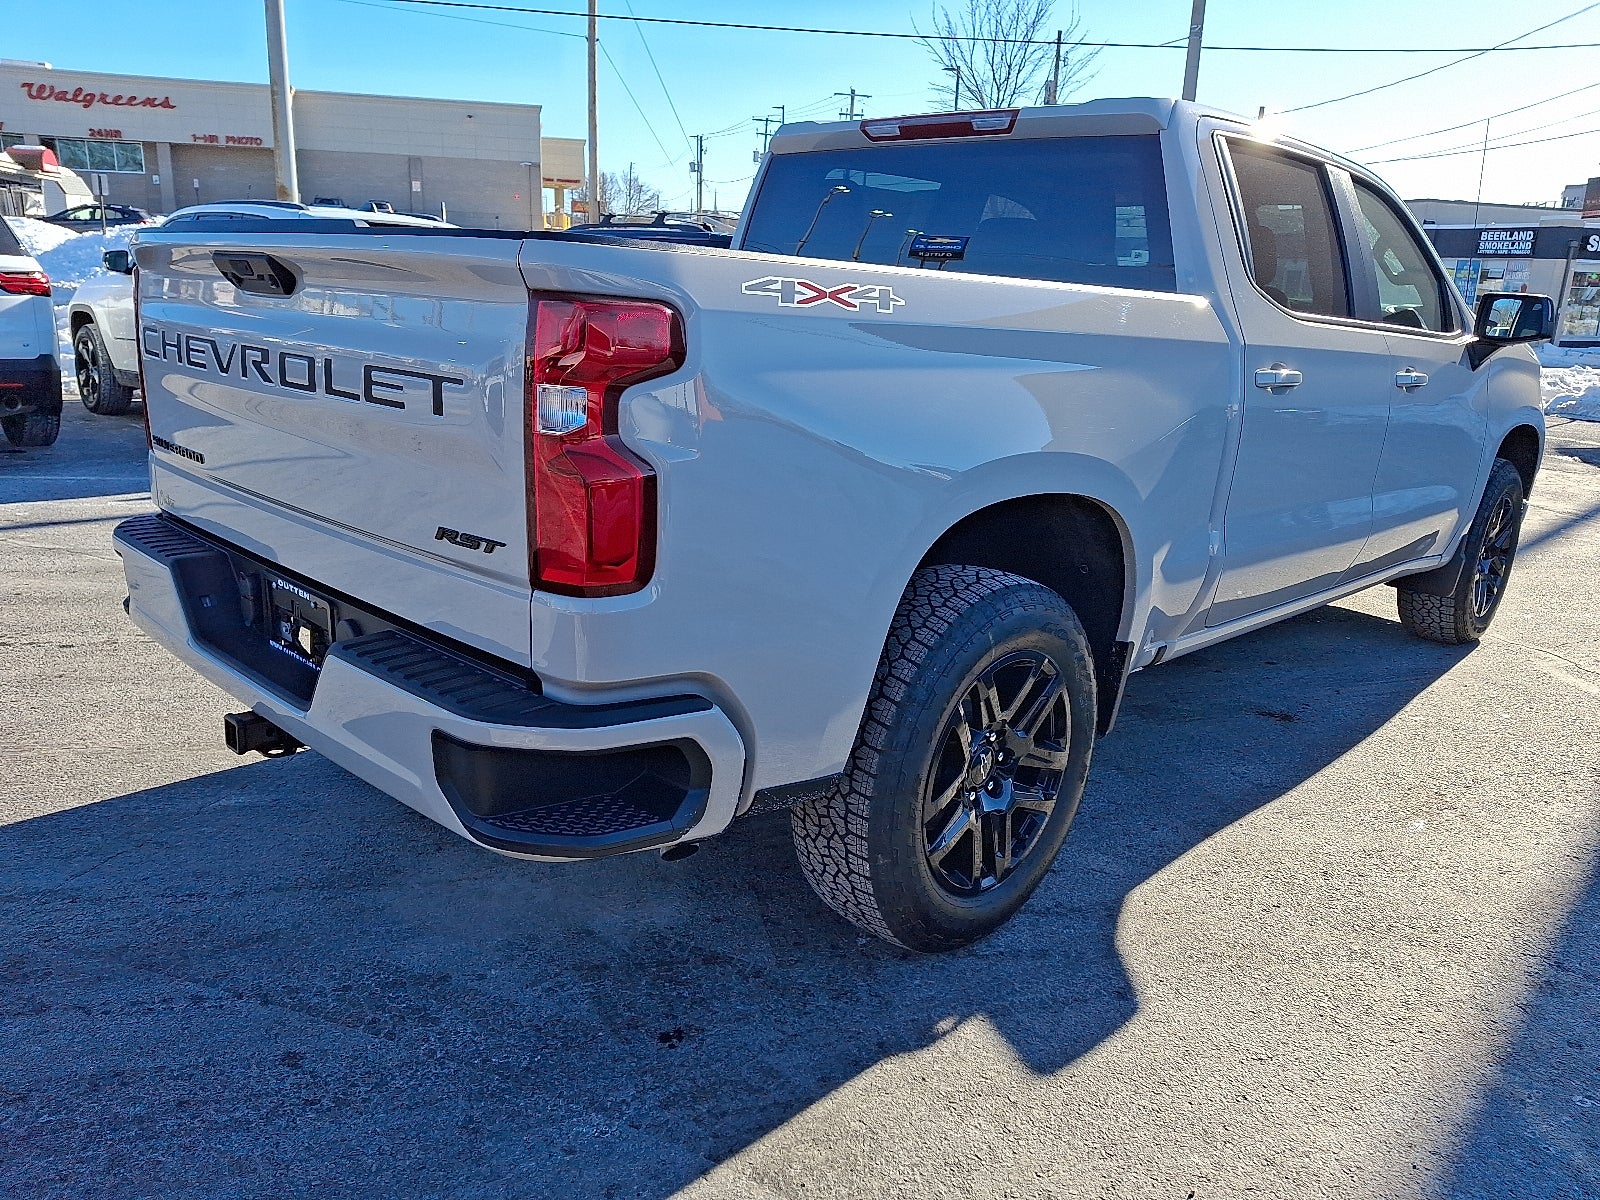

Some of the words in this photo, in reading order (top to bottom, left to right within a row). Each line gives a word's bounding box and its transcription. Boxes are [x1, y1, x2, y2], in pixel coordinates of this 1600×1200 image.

[21, 82, 177, 109] Walgreens
[225, 136, 262, 146] PHOTO
[1479, 241, 1532, 250] SMOKELAND
[1481, 231, 1534, 241] BEERLAND
[142, 326, 464, 417] CHEVROLET
[434, 525, 507, 554] RST
[277, 579, 311, 601] OUTTEN
